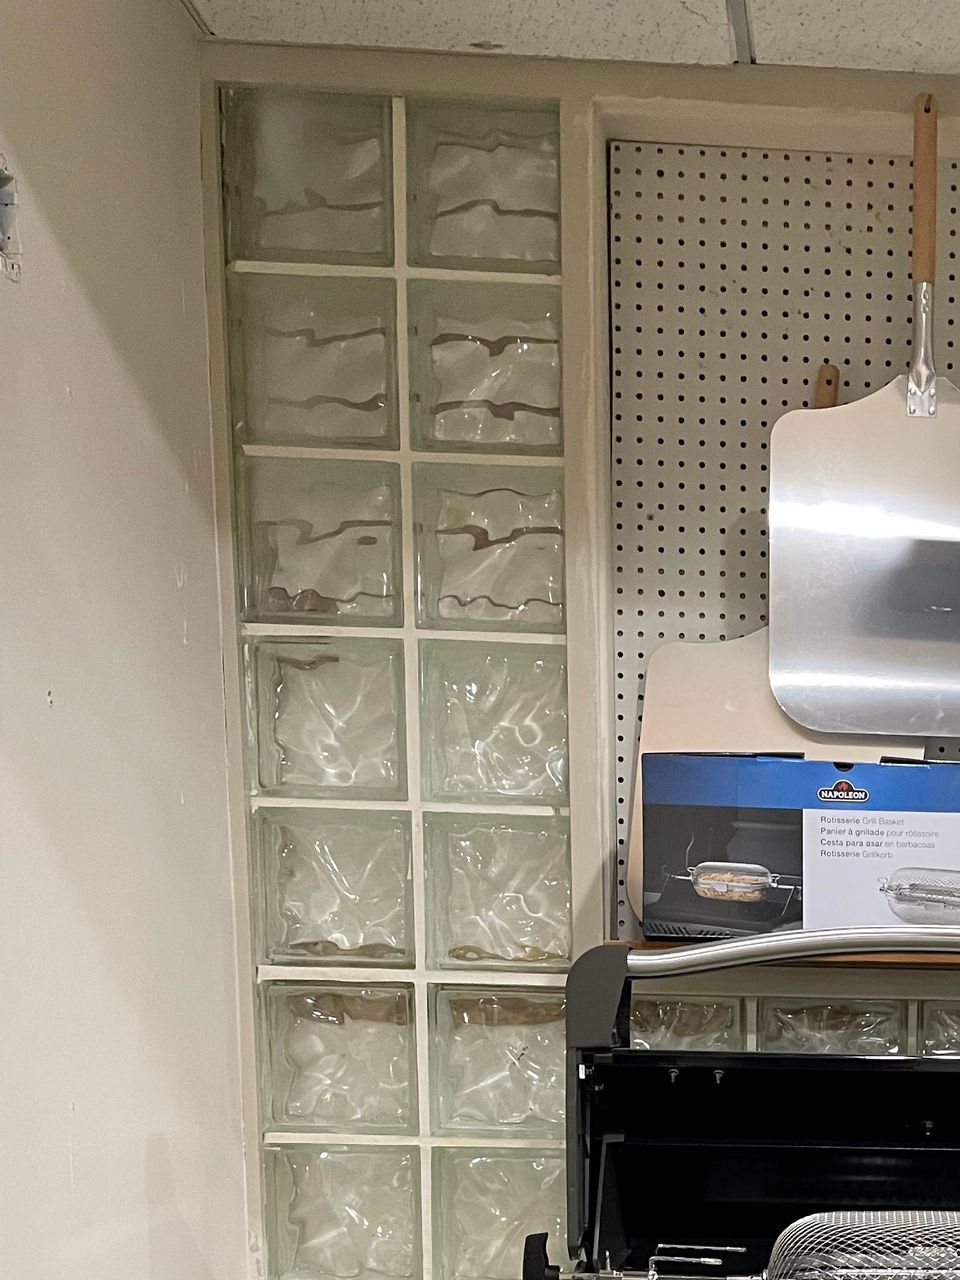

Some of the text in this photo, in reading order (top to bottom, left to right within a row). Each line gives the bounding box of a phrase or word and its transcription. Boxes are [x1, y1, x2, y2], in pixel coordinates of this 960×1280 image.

[821, 790, 866, 799] NAPOLEON
[820, 816, 904, 825] Rotisserie Grill Basket
[855, 829, 884, 838] grillade
[820, 839, 844, 847] Cesta
[897, 841, 935, 849] barbacoas
[820, 850, 893, 859] Rotisserie Grillkorb
